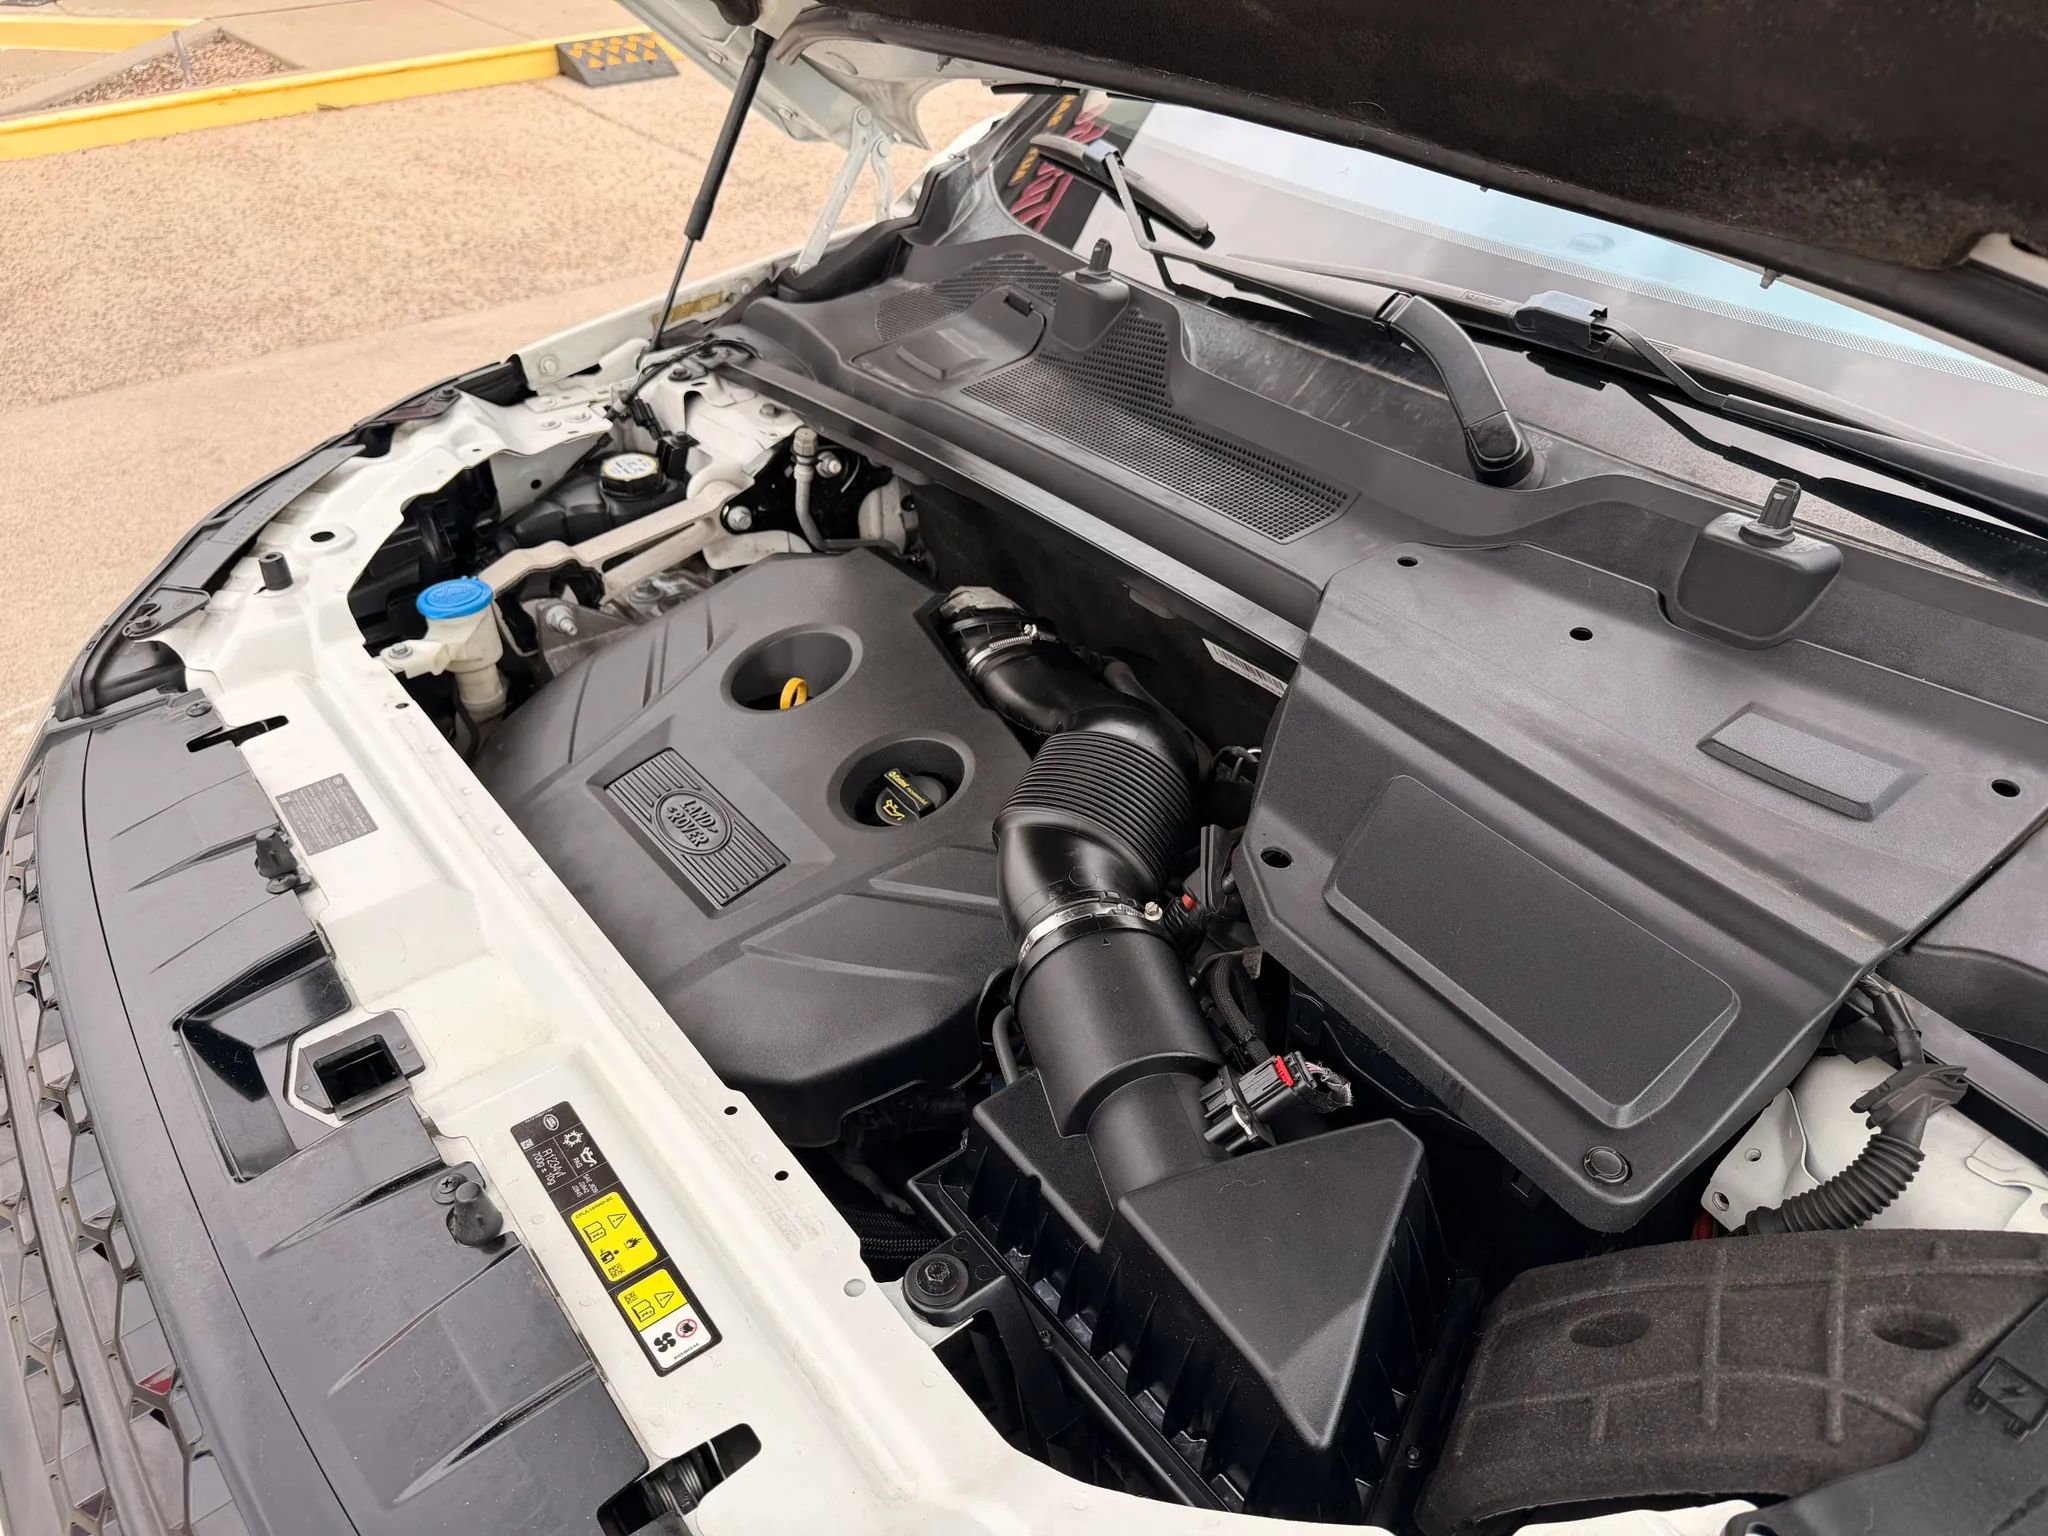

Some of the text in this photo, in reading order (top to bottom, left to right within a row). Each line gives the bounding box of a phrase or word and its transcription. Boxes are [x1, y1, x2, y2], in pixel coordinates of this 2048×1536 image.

[667, 809, 710, 848] ROVER
[680, 800, 717, 829] LAND
[532, 1151, 545, 1168] 700g
[542, 1148, 567, 1179] R1234yf
[572, 1157, 583, 1169] PAG
